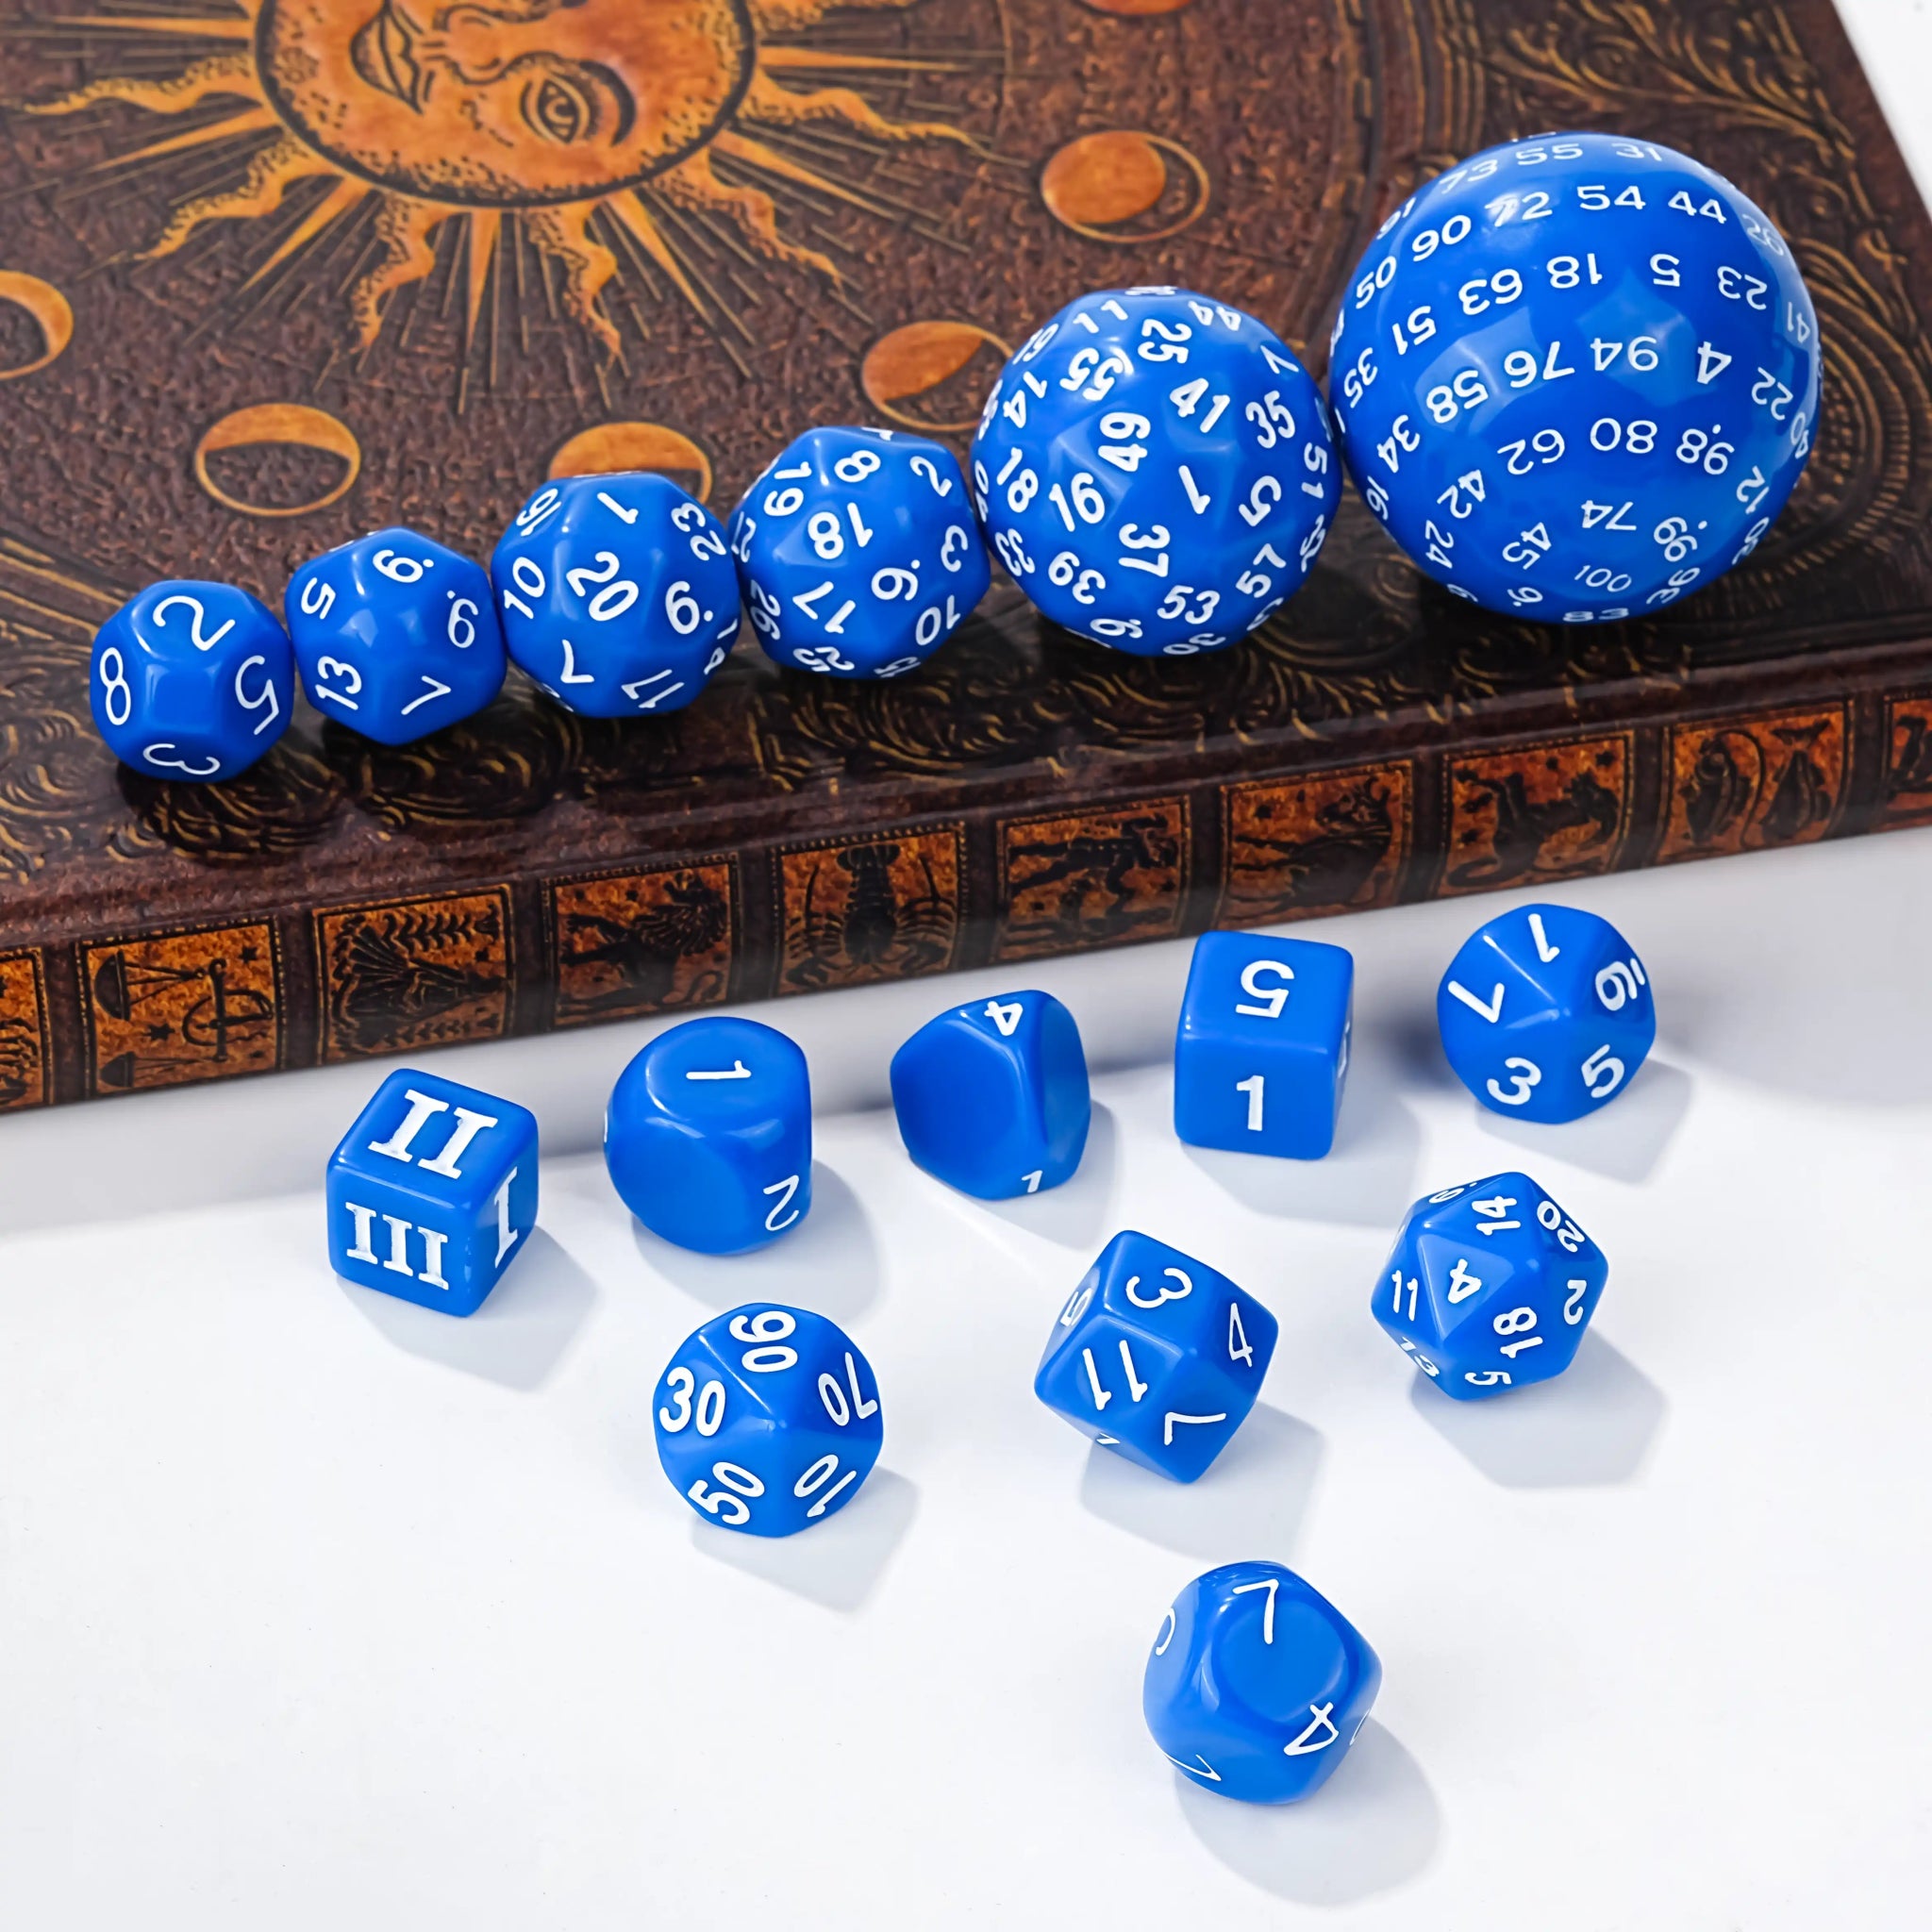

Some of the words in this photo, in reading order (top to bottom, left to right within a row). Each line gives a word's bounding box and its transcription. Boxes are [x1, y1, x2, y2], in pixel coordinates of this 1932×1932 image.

[1515, 143, 1584, 166] 55
[1611, 142, 1662, 161] 31
[1439, 159, 1499, 194] 73
[1576, 185, 1647, 211] 54
[1485, 192, 1553, 227] 72
[1667, 191, 1727, 225] 44
[1411, 214, 1472, 262] 90
[1355, 256, 1397, 309] 50
[1457, 268, 1524, 315] 63
[1546, 252, 1604, 290] 18
[1649, 253, 1681, 287] 5
[1716, 265, 1768, 311] 23
[1073, 300, 1128, 333] 11
[1391, 306, 1436, 355] 51
[1138, 319, 1192, 364] 25
[1504, 341, 1575, 389] 76
[1590, 336, 1660, 372] 94
[1697, 341, 1732, 385] 4
[1004, 372, 1047, 428] 14
[1343, 347, 1378, 408] 35
[1425, 369, 1489, 424] 58
[1750, 366, 1794, 421] 22
[1170, 378, 1230, 432] 41
[1245, 391, 1295, 448] 35
[1098, 411, 1151, 473] 49
[1377, 415, 1420, 473] 34
[1497, 429, 1566, 475] 62
[1590, 418, 1657, 454] 80
[834, 450, 881, 482] 8
[910, 456, 953, 496] 2
[997, 447, 1039, 512] 18
[1178, 465, 1210, 514] 1
[597, 492, 639, 525] 1
[1049, 472, 1106, 531] 16
[1239, 475, 1282, 526] 5
[1437, 470, 1486, 519] 42
[1581, 500, 1637, 531] 74
[671, 502, 726, 561] 23
[808, 503, 873, 559] 18
[941, 525, 968, 572] 3
[994, 529, 1035, 576] 33
[1118, 523, 1171, 577] 37
[1425, 520, 1454, 569] 24
[1502, 523, 1552, 570] 45
[504, 557, 545, 619] 10
[566, 551, 639, 622] 20
[1048, 551, 1106, 604] 39
[1236, 543, 1287, 598] 57
[1574, 565, 1634, 592] 100
[153, 595, 236, 651] 2
[301, 577, 337, 620] 5
[792, 581, 856, 633] 17
[915, 594, 960, 645] 10
[1157, 585, 1220, 625] 53
[99, 647, 131, 725] 8
[315, 656, 362, 710] 13
[560, 640, 594, 684] 7
[235, 656, 279, 735] 5
[401, 675, 452, 715] 7
[621, 669, 685, 708] 17
[143, 743, 221, 775] 3
[1528, 913, 1559, 962] 1
[1236, 960, 1295, 1018] 5
[1448, 980, 1505, 1024] 7
[984, 1001, 1024, 1037] 4
[686, 1060, 752, 1080] 1
[1487, 1057, 1541, 1106] 3
[1581, 1044, 1624, 1098] 5
[1236, 1075, 1265, 1131] 1
[368, 1089, 499, 1179] II
[763, 1174, 800, 1231] 2
[1022, 1170, 1043, 1193] 1
[494, 1167, 519, 1269] I
[1472, 1196, 1521, 1235] 14
[1537, 1201, 1585, 1252] 20
[345, 1202, 449, 1291] III
[1125, 1268, 1192, 1308] 3
[1391, 1271, 1418, 1321] 11
[1448, 1259, 1482, 1304] 4
[1563, 1280, 1587, 1324] 2
[729, 1310, 798, 1373] 90
[1228, 1303, 1253, 1367] 4
[1493, 1307, 1542, 1358] 18
[818, 1352, 878, 1426] 70
[1082, 1340, 1148, 1410] 11
[1465, 1372, 1511, 1385] 5
[659, 1366, 725, 1437] 30
[1164, 1411, 1226, 1445] 7
[687, 1461, 765, 1524] 50
[794, 1454, 857, 1518] 10
[1232, 1578, 1279, 1644] 7
[1283, 1702, 1339, 1756] 4
